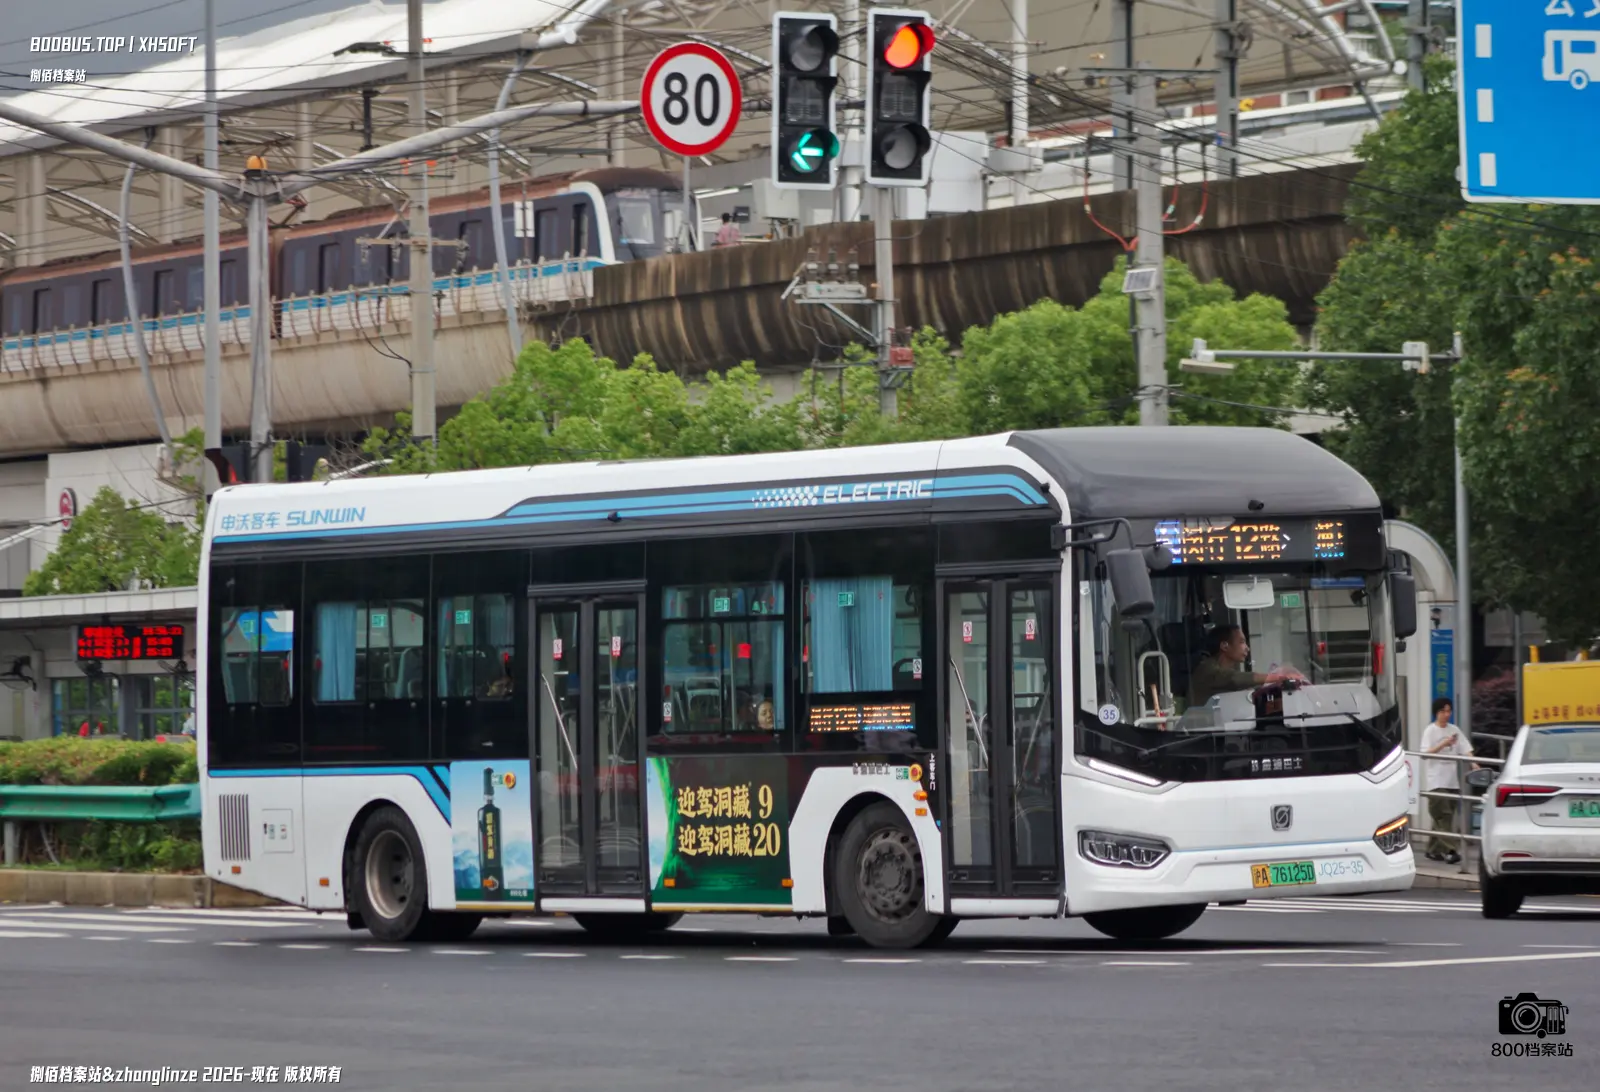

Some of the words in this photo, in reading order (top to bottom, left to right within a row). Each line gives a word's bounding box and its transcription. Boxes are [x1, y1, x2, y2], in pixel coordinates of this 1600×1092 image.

[663, 72, 720, 127] 80
[822, 479, 934, 504] ELECTRIC
[220, 511, 281, 531] 申沃客车
[286, 506, 367, 527] SUNWIN
[1102, 709, 1116, 721] 35
[677, 784, 752, 819] 迎驾洞藏
[758, 784, 773, 819] 9
[678, 822, 753, 857] 迎驾洞藏
[753, 822, 781, 857] 20
[1318, 860, 1364, 877] JQ25-35
